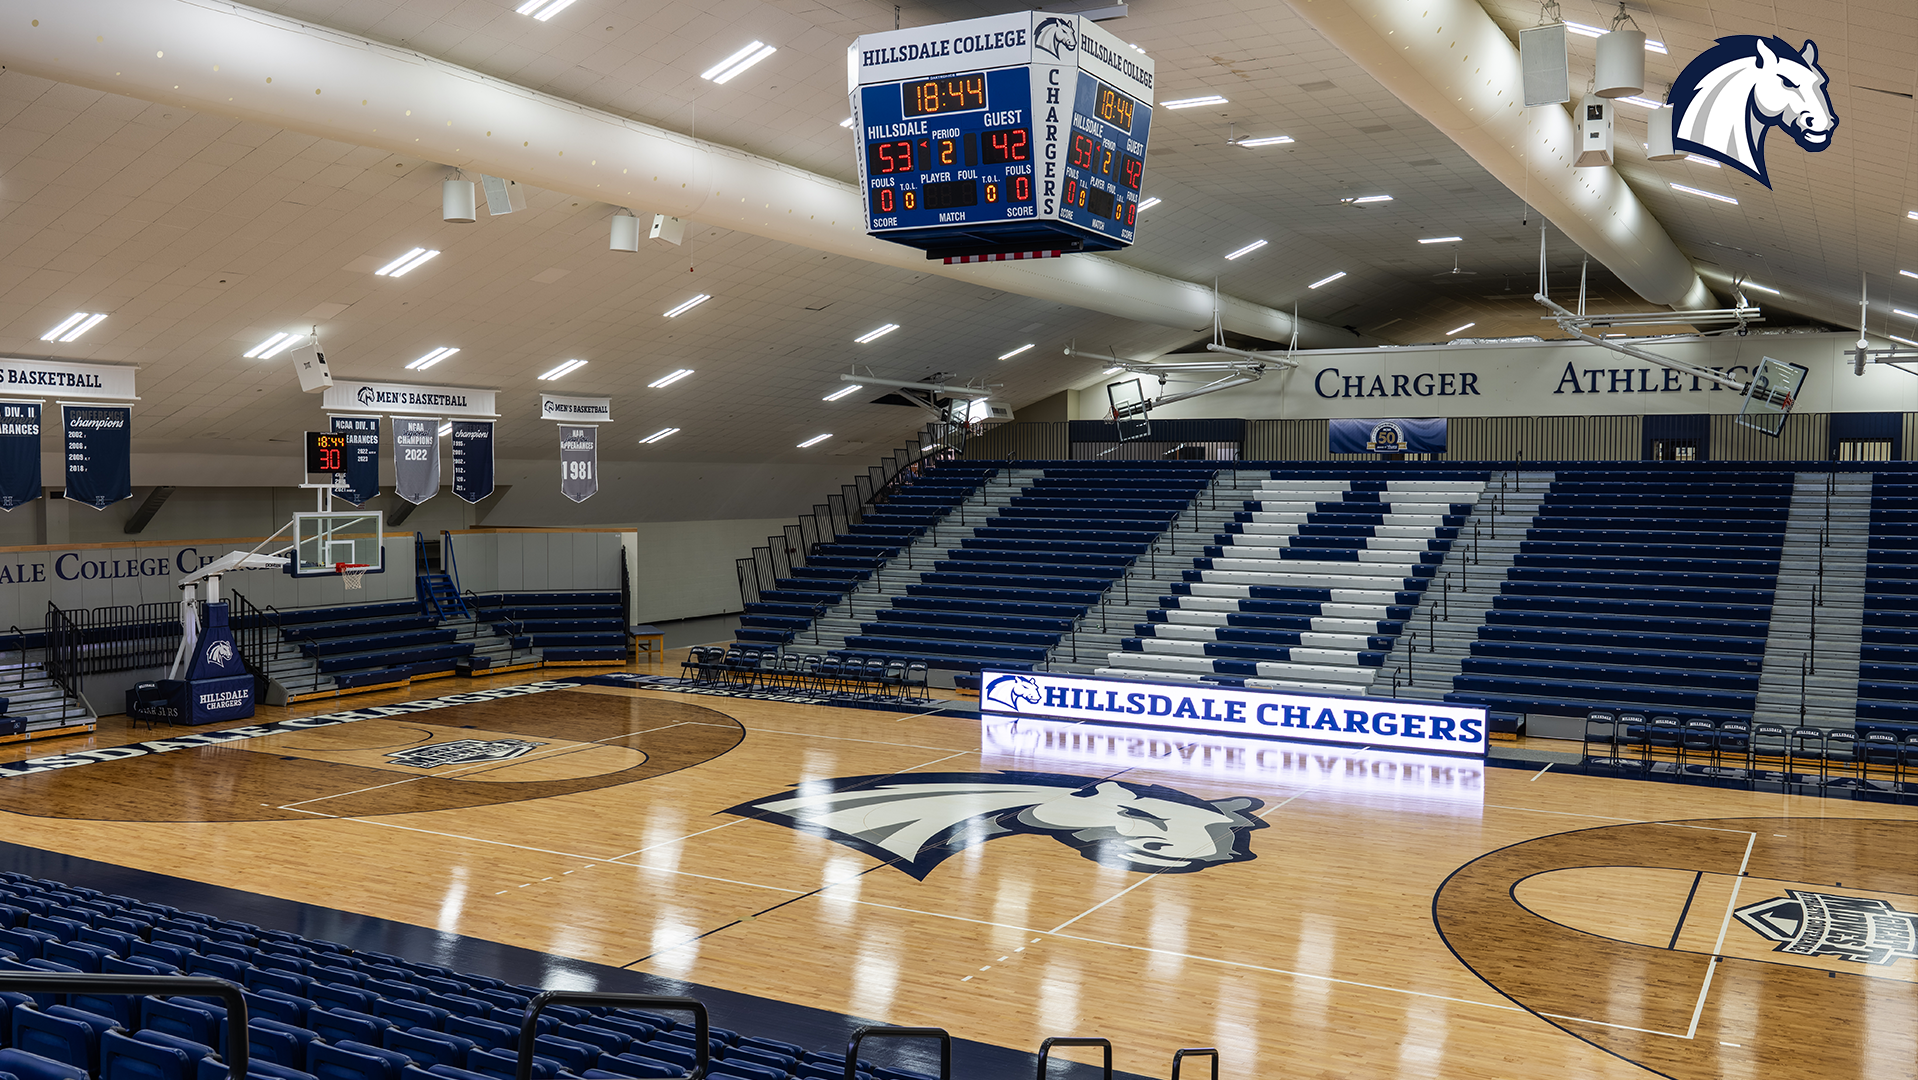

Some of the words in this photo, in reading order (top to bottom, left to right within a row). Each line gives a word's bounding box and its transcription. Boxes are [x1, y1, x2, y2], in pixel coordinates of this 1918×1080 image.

[863, 39, 949, 66] HILLSDALE
[953, 28, 1026, 54] COLLEGE
[1080, 33, 1122, 72] HILLSDALE
[1123, 59, 1152, 89] COLLEGE
[916, 78, 982, 112] 18:44
[1101, 90, 1133, 128] 18:44
[984, 110, 1022, 127] GUEST
[1073, 112, 1104, 138] HILLSDALE
[868, 121, 928, 140] HILLSDALE
[932, 128, 961, 140] PERIOD
[992, 129, 1026, 160] 42
[1043, 69, 1060, 215] CHARGERS
[1102, 138, 1116, 151] PERIOD
[1126, 138, 1144, 156] GUEST
[879, 141, 912, 173] 53
[941, 140, 953, 164] 2
[1074, 135, 1092, 168] 53
[1005, 164, 1032, 176] FOULS
[1103, 151, 1112, 174] 2
[920, 172, 950, 184] PLAYER
[957, 170, 978, 180] FOUL
[982, 175, 1000, 184] T.O.L.
[1066, 166, 1079, 180] FOULS
[1126, 159, 1142, 188] 42
[871, 177, 895, 188] FOULS
[1016, 176, 1028, 200] 0
[1090, 176, 1105, 190] PLAYER
[986, 184, 996, 202] 0
[1067, 180, 1076, 204] 0
[1079, 190, 1086, 206] 0
[881, 189, 893, 212] 0
[905, 192, 914, 209] 0
[939, 211, 966, 222] MATCH
[1006, 206, 1034, 218] SCORE
[1060, 208, 1074, 220] SCORE
[1115, 204, 1122, 220] 0
[1127, 204, 1136, 225] 0
[873, 216, 898, 228] SCORE
[1091, 219, 1105, 230] MATCH
[1121, 229, 1133, 240] SCORE
[7, 369, 102, 388] BASKETBALL
[376, 391, 407, 404] MEN'S
[409, 393, 468, 407] BASKETBALL
[4, 406, 24, 418] DIV.
[27, 407, 34, 418] II
[69, 410, 124, 420] CONFERENCE
[554, 403, 572, 412] MEN'S
[573, 405, 608, 414] BASKETBALL
[69, 416, 124, 430] champions
[335, 420, 353, 430] NCAA
[355, 421, 368, 430] DIV.
[370, 421, 376, 430] II
[408, 422, 424, 432] NCAA
[317, 436, 344, 448] 18:44
[397, 435, 433, 445] CHAMPIONS
[454, 429, 488, 440] champions
[1378, 431, 1396, 444] 50
[560, 441, 594, 450] APPEARANCES
[320, 449, 340, 470] 30
[404, 448, 428, 460] 2022
[562, 460, 592, 480] 1981
[55, 552, 170, 581] COLLEGE
[200, 689, 248, 704] HILLSDALE
[734, 692, 830, 704] COURT
[206, 699, 242, 710] CHARGERS
[278, 681, 583, 728] CHARGERS
[1043, 685, 1247, 724] HILLSDALE
[1256, 702, 1483, 743] CHARGERS
[1795, 729, 1820, 737] HILLSDALE
[1831, 732, 1855, 740] HILLSDALE
[1869, 734, 1894, 742] HILLSDALE
[1815, 895, 1889, 963] MIDWEST
[1872, 915, 1910, 950] GREAT
